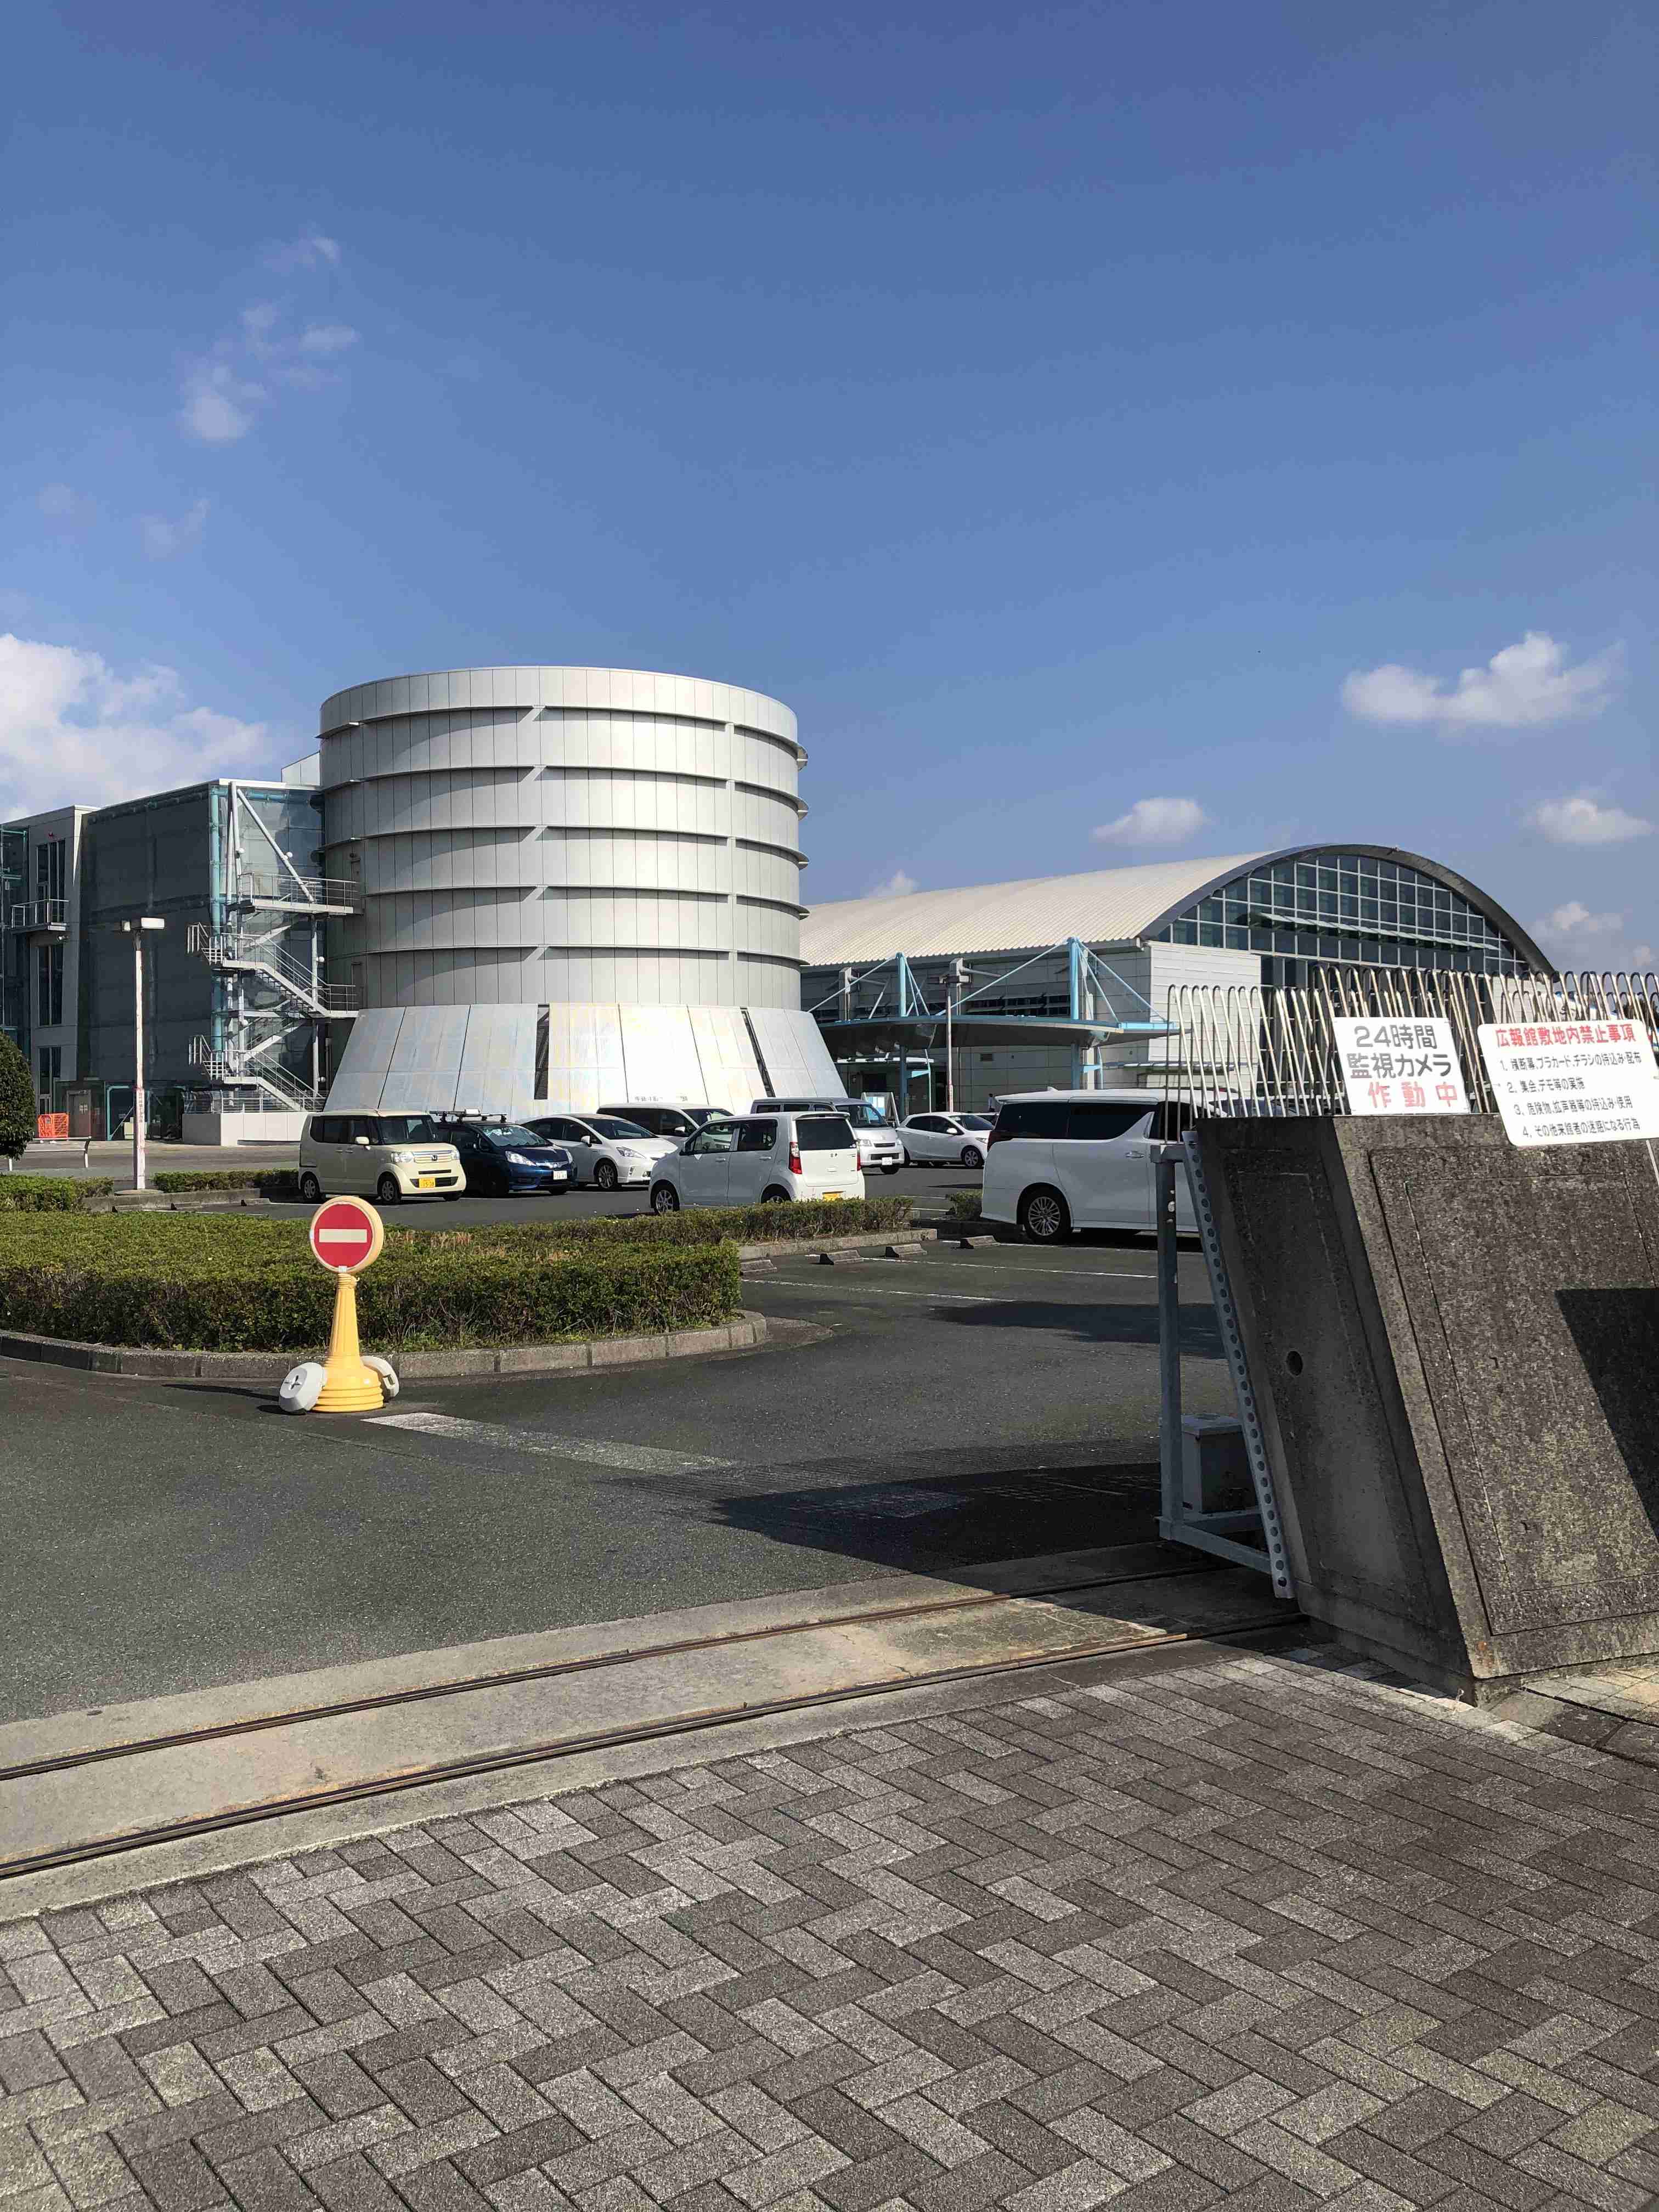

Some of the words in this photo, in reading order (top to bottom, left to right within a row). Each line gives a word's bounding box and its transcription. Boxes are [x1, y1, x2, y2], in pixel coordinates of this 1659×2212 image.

[1354, 1024, 1437, 1049] 24時間
[1495, 1024, 1637, 1047] 広報館敷地内禁止事項
[1347, 1053, 1452, 1079] 監視カメラ
